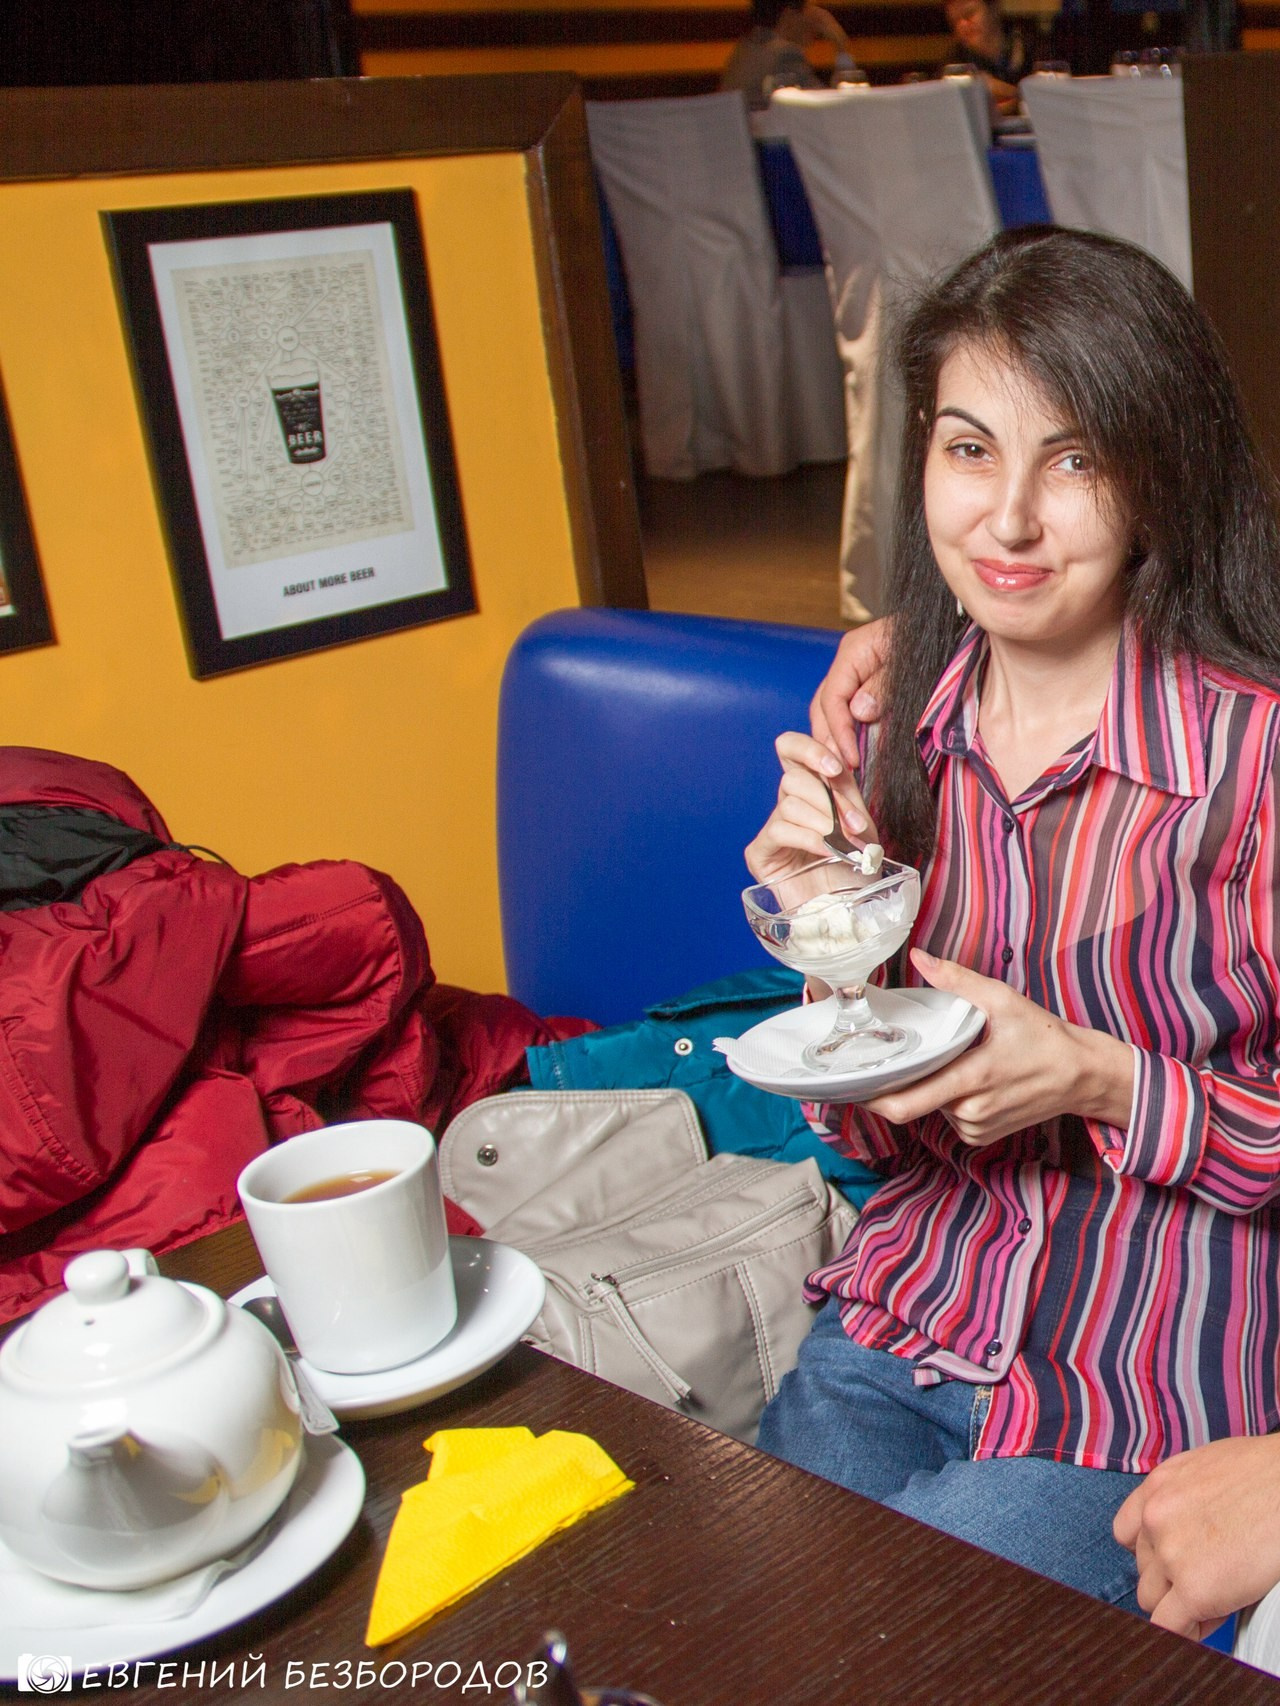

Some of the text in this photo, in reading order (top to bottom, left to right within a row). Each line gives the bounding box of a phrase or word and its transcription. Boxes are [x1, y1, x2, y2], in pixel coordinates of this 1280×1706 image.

[288, 431, 322, 448] BEER
[283, 567, 376, 596] ABOUT MORE BEER
